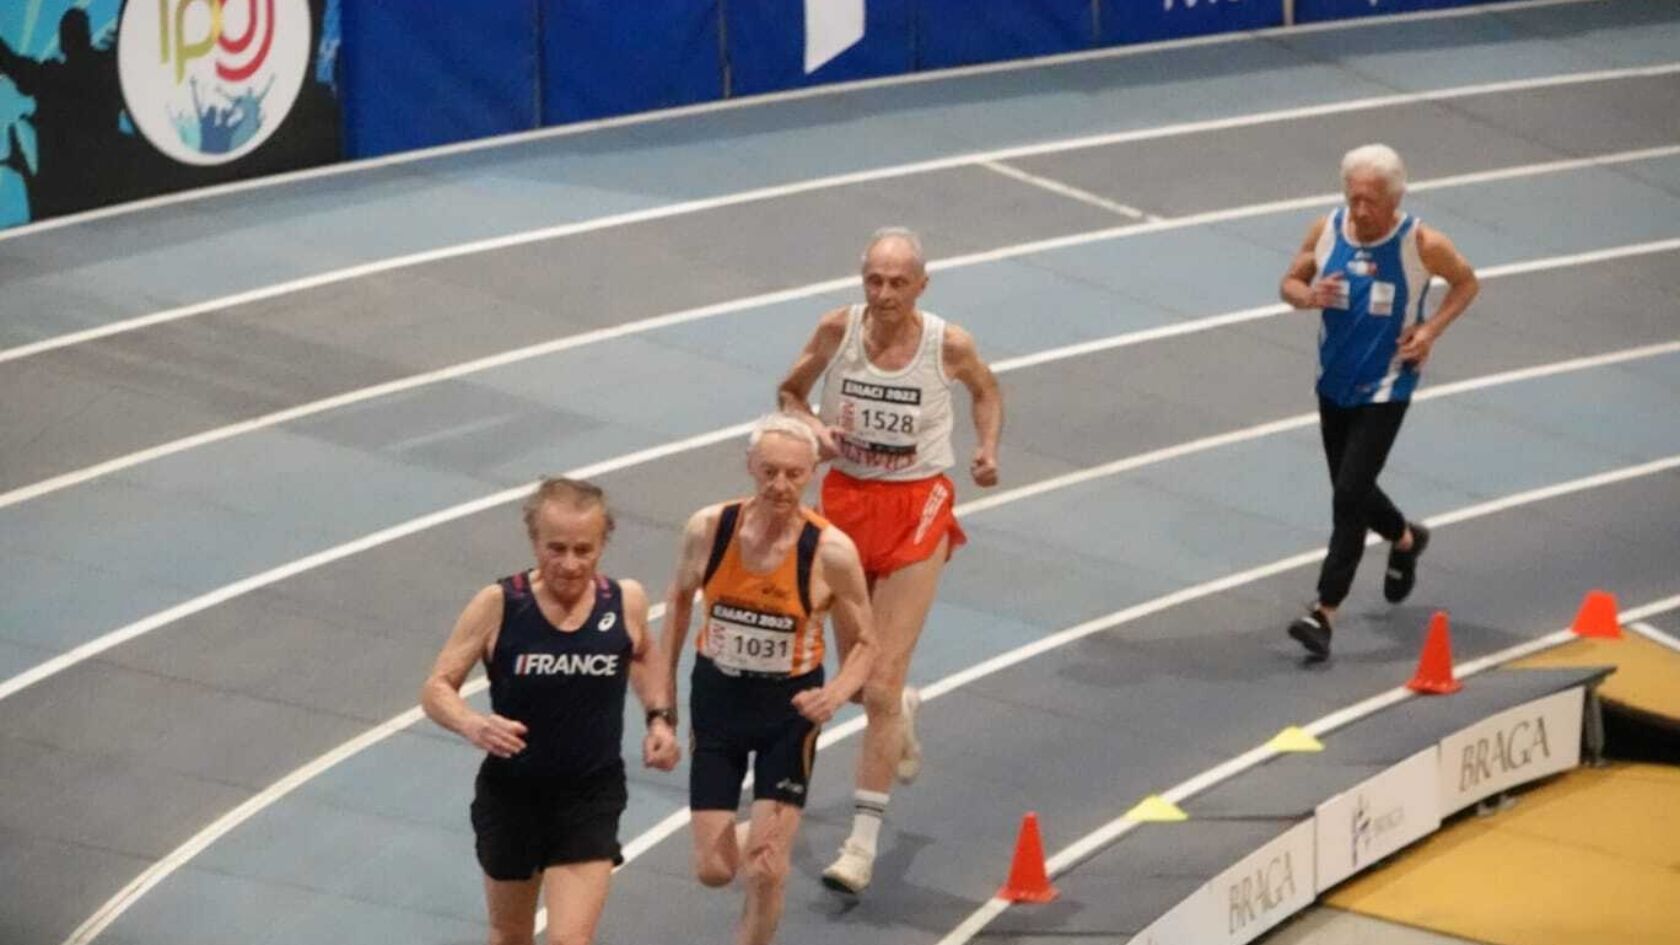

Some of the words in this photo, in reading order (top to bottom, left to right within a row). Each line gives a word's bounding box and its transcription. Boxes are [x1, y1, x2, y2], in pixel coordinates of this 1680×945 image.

[885, 387, 920, 404] 2022
[860, 408, 914, 434] 1528
[734, 635, 789, 659] 1031
[525, 653, 619, 677] FRANCE
[1460, 716, 1550, 792] BRAGA
[1228, 851, 1296, 935] BRAGA
